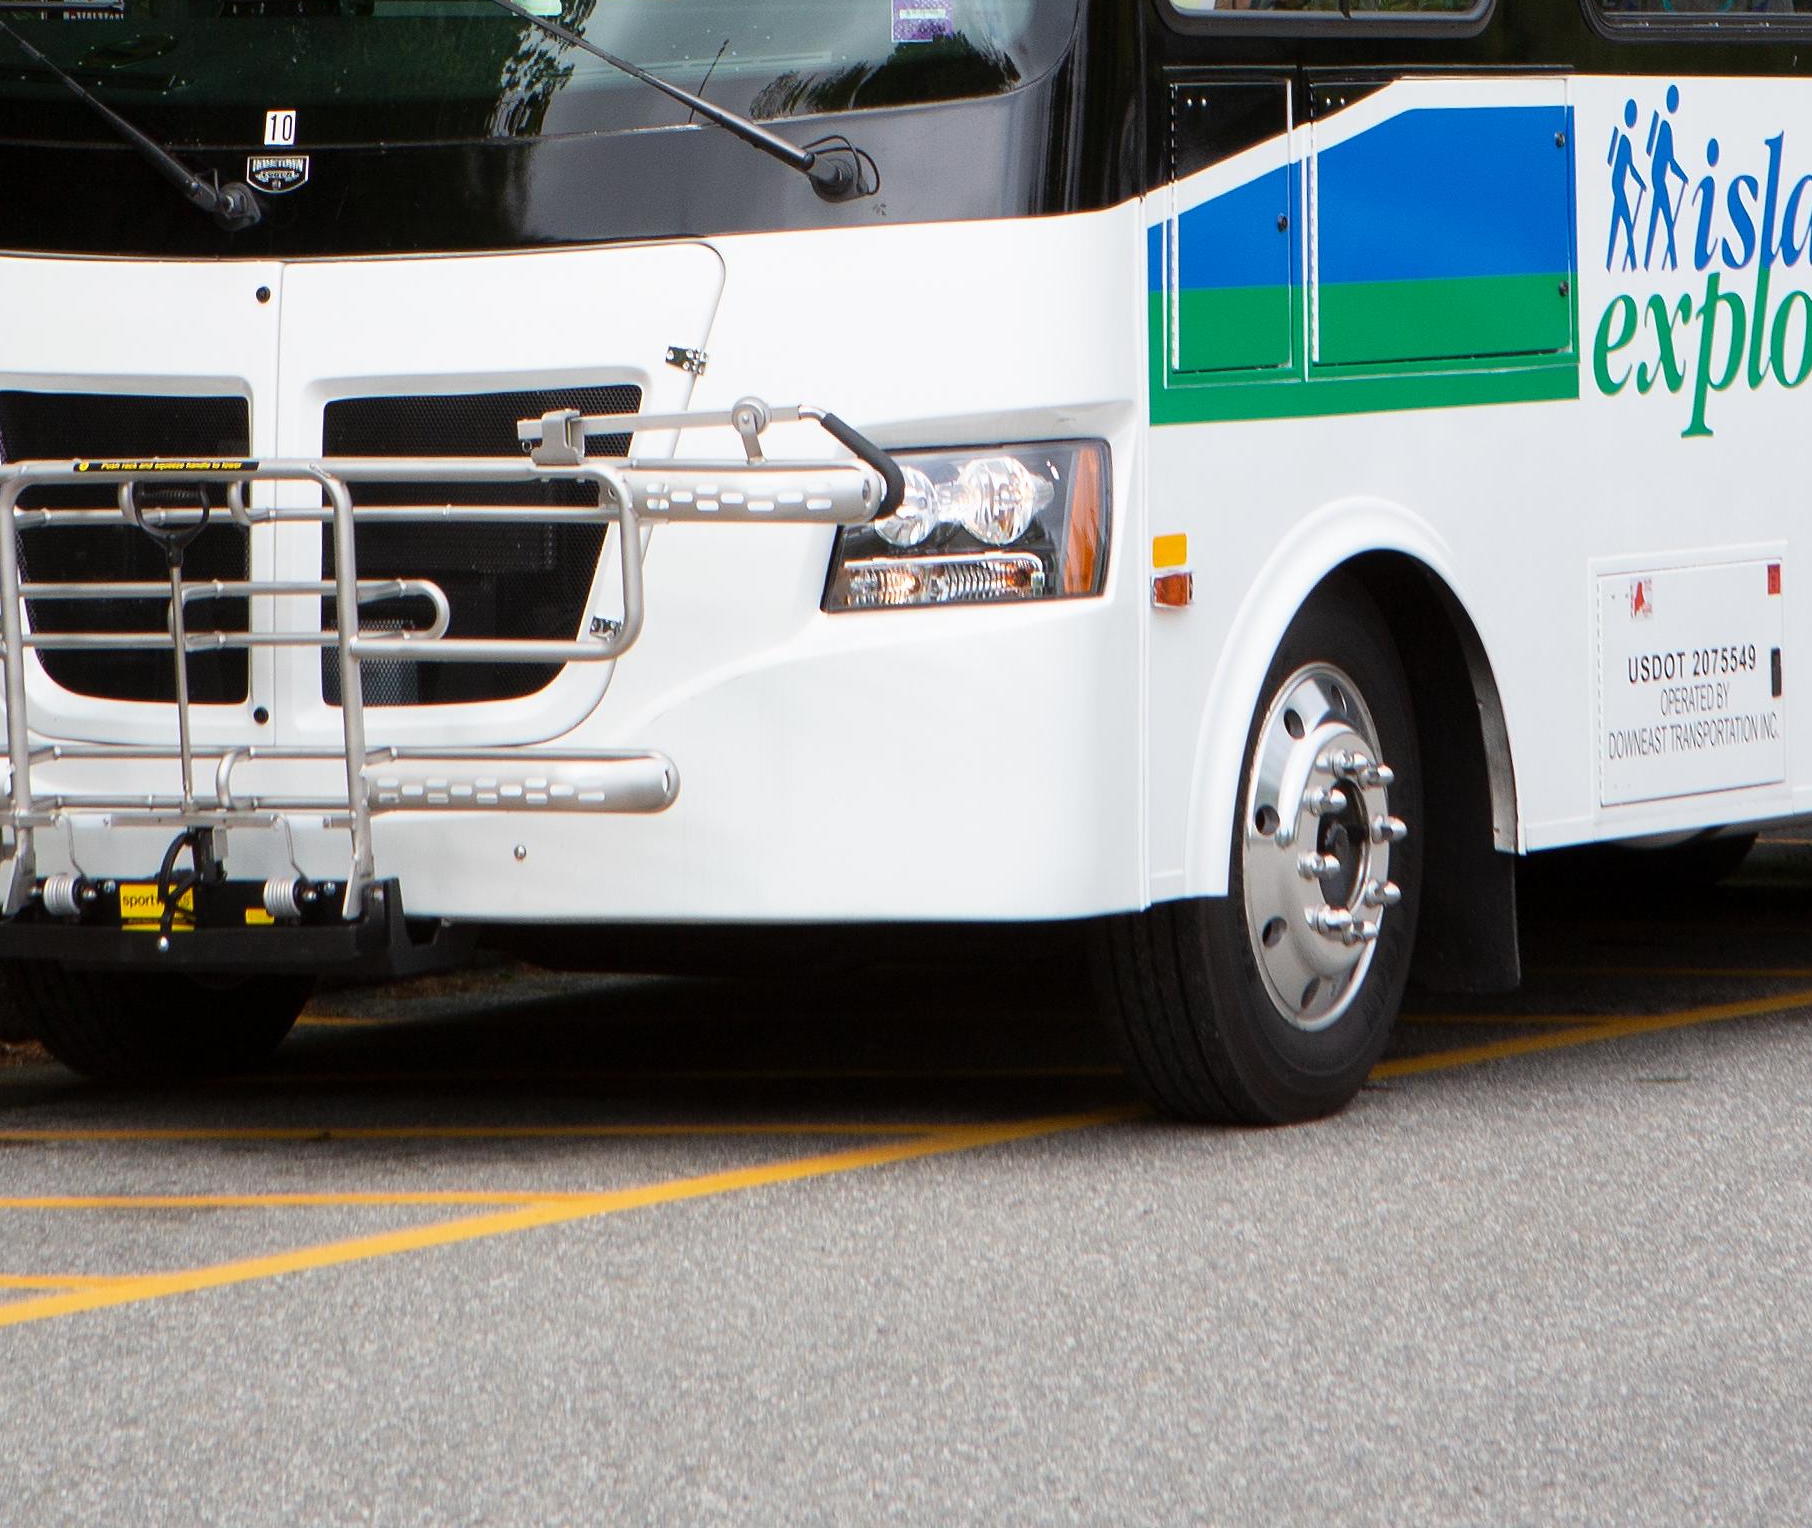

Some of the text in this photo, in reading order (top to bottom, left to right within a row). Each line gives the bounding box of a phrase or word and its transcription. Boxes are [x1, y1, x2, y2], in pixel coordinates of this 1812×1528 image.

[270, 114, 293, 141] 10
[1627, 644, 1756, 684] USDOT 2075549
[1660, 681, 1731, 716] OPERATED BY
[1608, 724, 1668, 760] DOWNEAST
[1669, 713, 1759, 753] TRANSPORTATION
